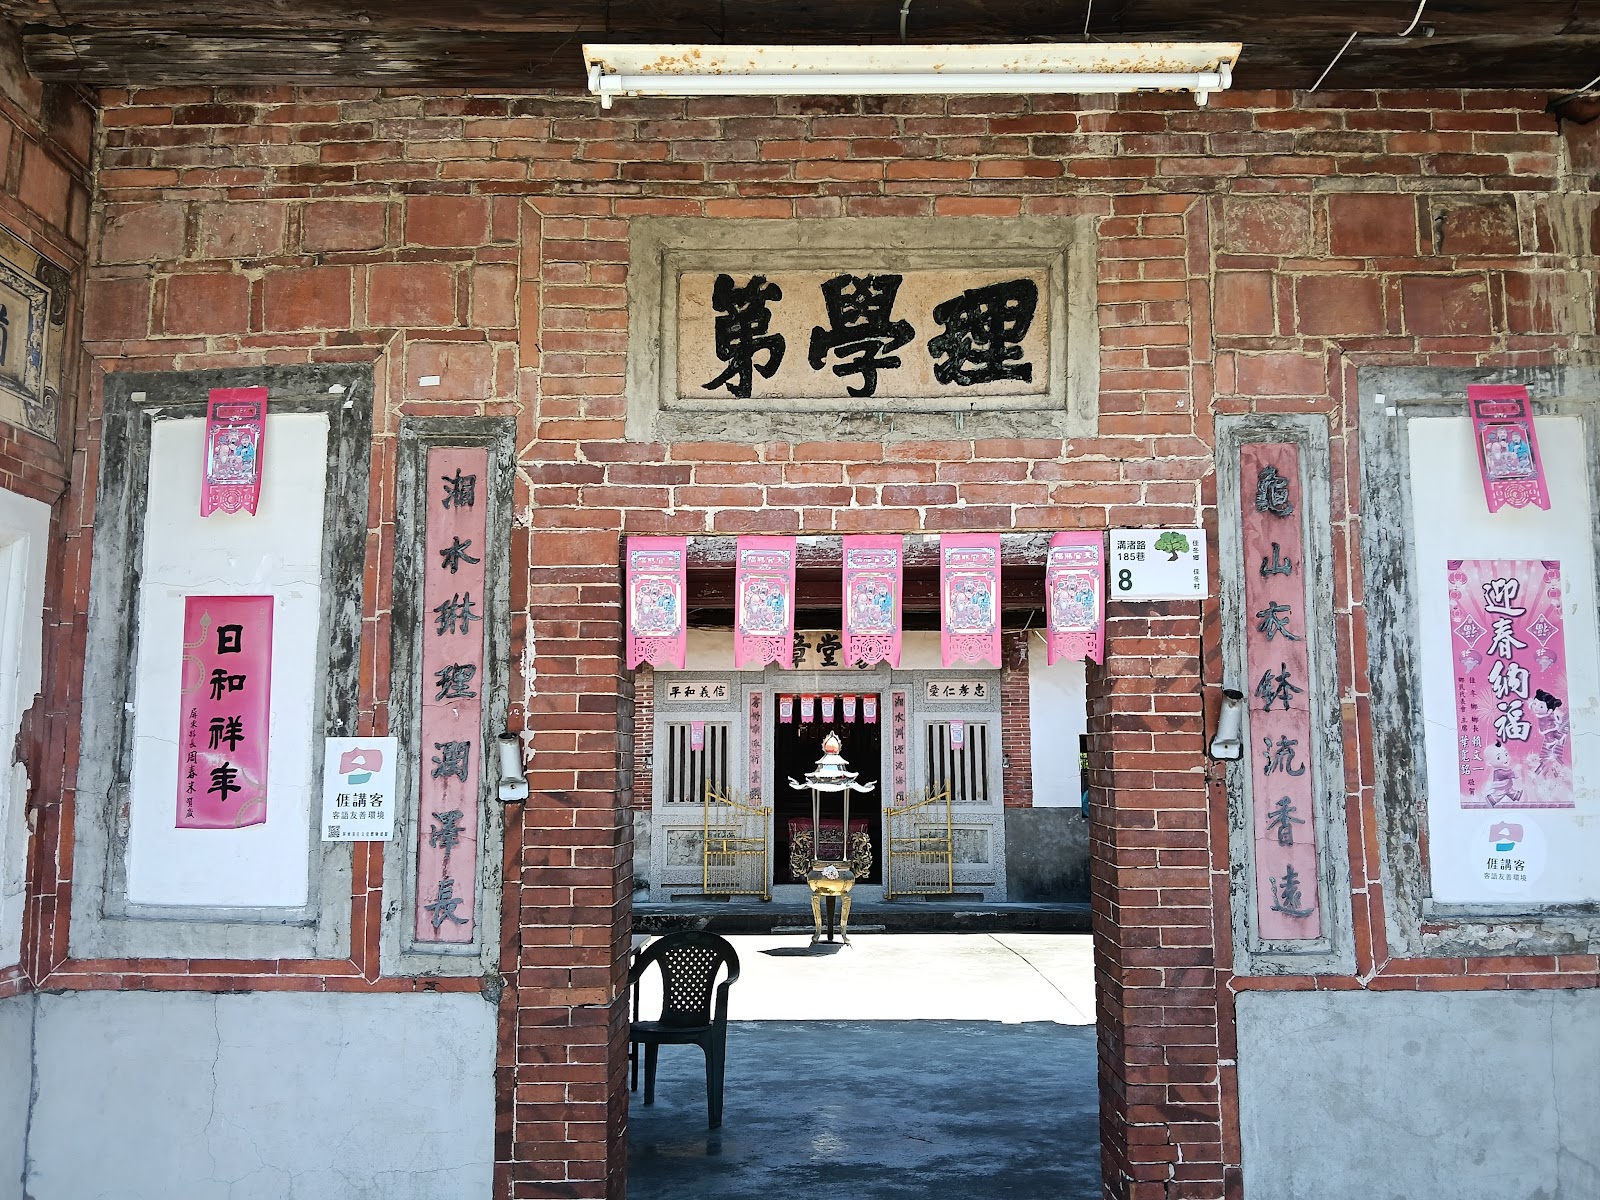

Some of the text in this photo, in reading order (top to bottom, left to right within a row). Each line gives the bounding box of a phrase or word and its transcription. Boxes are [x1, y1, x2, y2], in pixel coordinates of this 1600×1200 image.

[1116, 540, 1146, 550] 溝渚路
[1117, 552, 1145, 561] 185巷
[1118, 568, 1133, 591] 8
[1482, 577, 1532, 743] 迎春納福
[669, 685, 726, 698] 信義和平
[929, 683, 985, 697] 忠孝仁愛
[207, 624, 247, 802] 日和祥年
[332, 810, 385, 820] 客語友善環境
[1483, 872, 1527, 882] 客語友善環境
